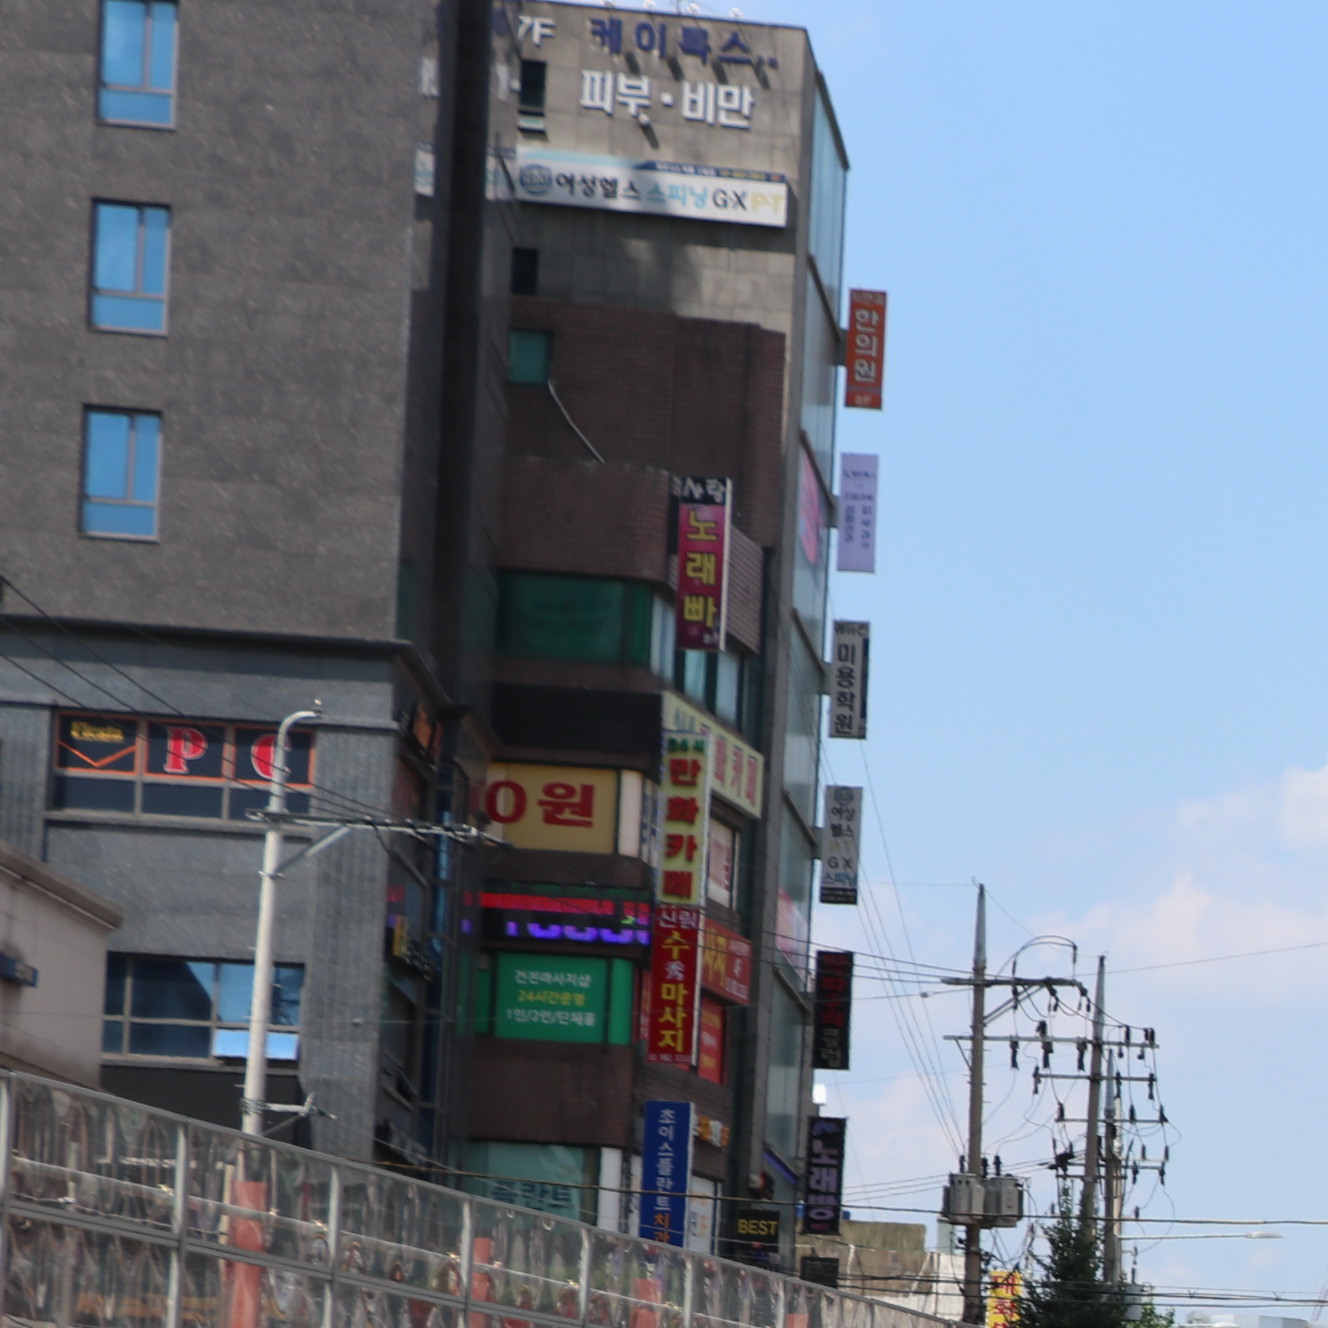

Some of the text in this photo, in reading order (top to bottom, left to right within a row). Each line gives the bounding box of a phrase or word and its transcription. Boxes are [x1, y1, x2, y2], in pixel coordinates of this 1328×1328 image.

[853, 308, 881, 384] 한의원
[682, 508, 718, 629] 노래빠
[834, 643, 857, 738] 미용학원
[657, 909, 699, 930] 신림
[737, 1219, 780, 1236] BEST
